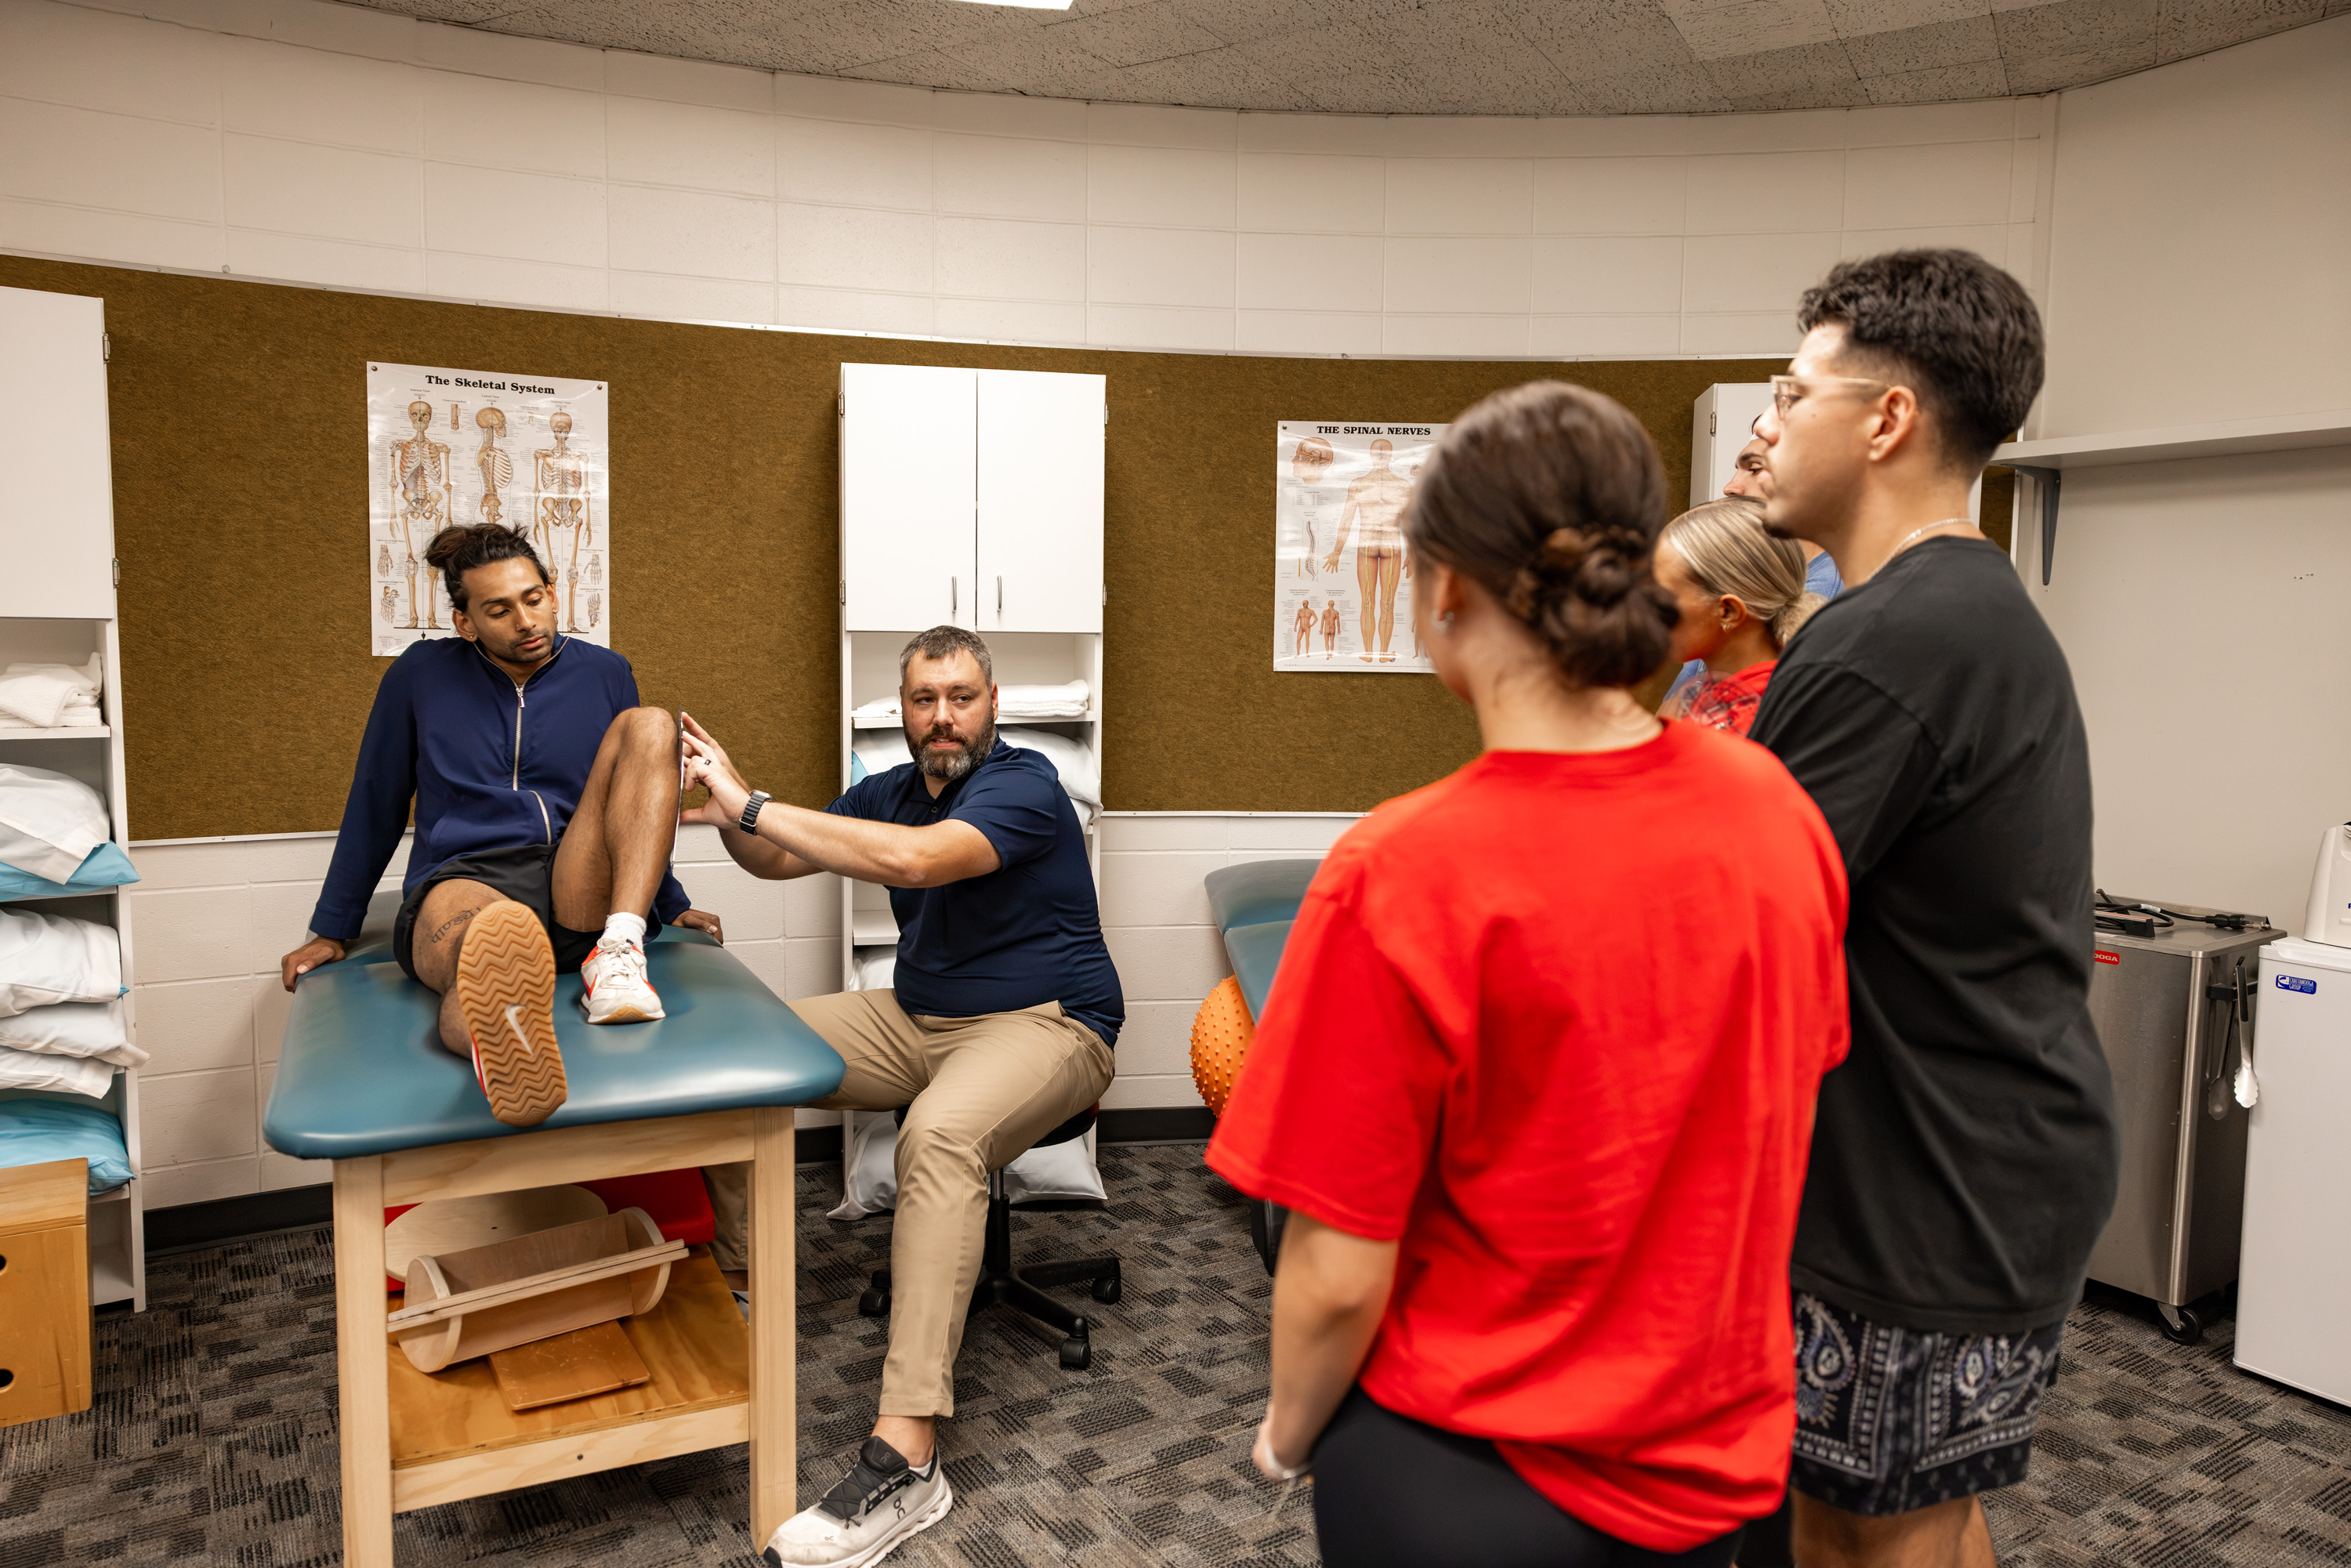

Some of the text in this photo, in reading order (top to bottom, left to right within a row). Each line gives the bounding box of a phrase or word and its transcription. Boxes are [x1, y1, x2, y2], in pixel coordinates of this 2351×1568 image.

[426, 375, 555, 394] The Skeletal System
[1343, 426, 1383, 435] SPINAL
[1387, 427, 1431, 436] NERVES
